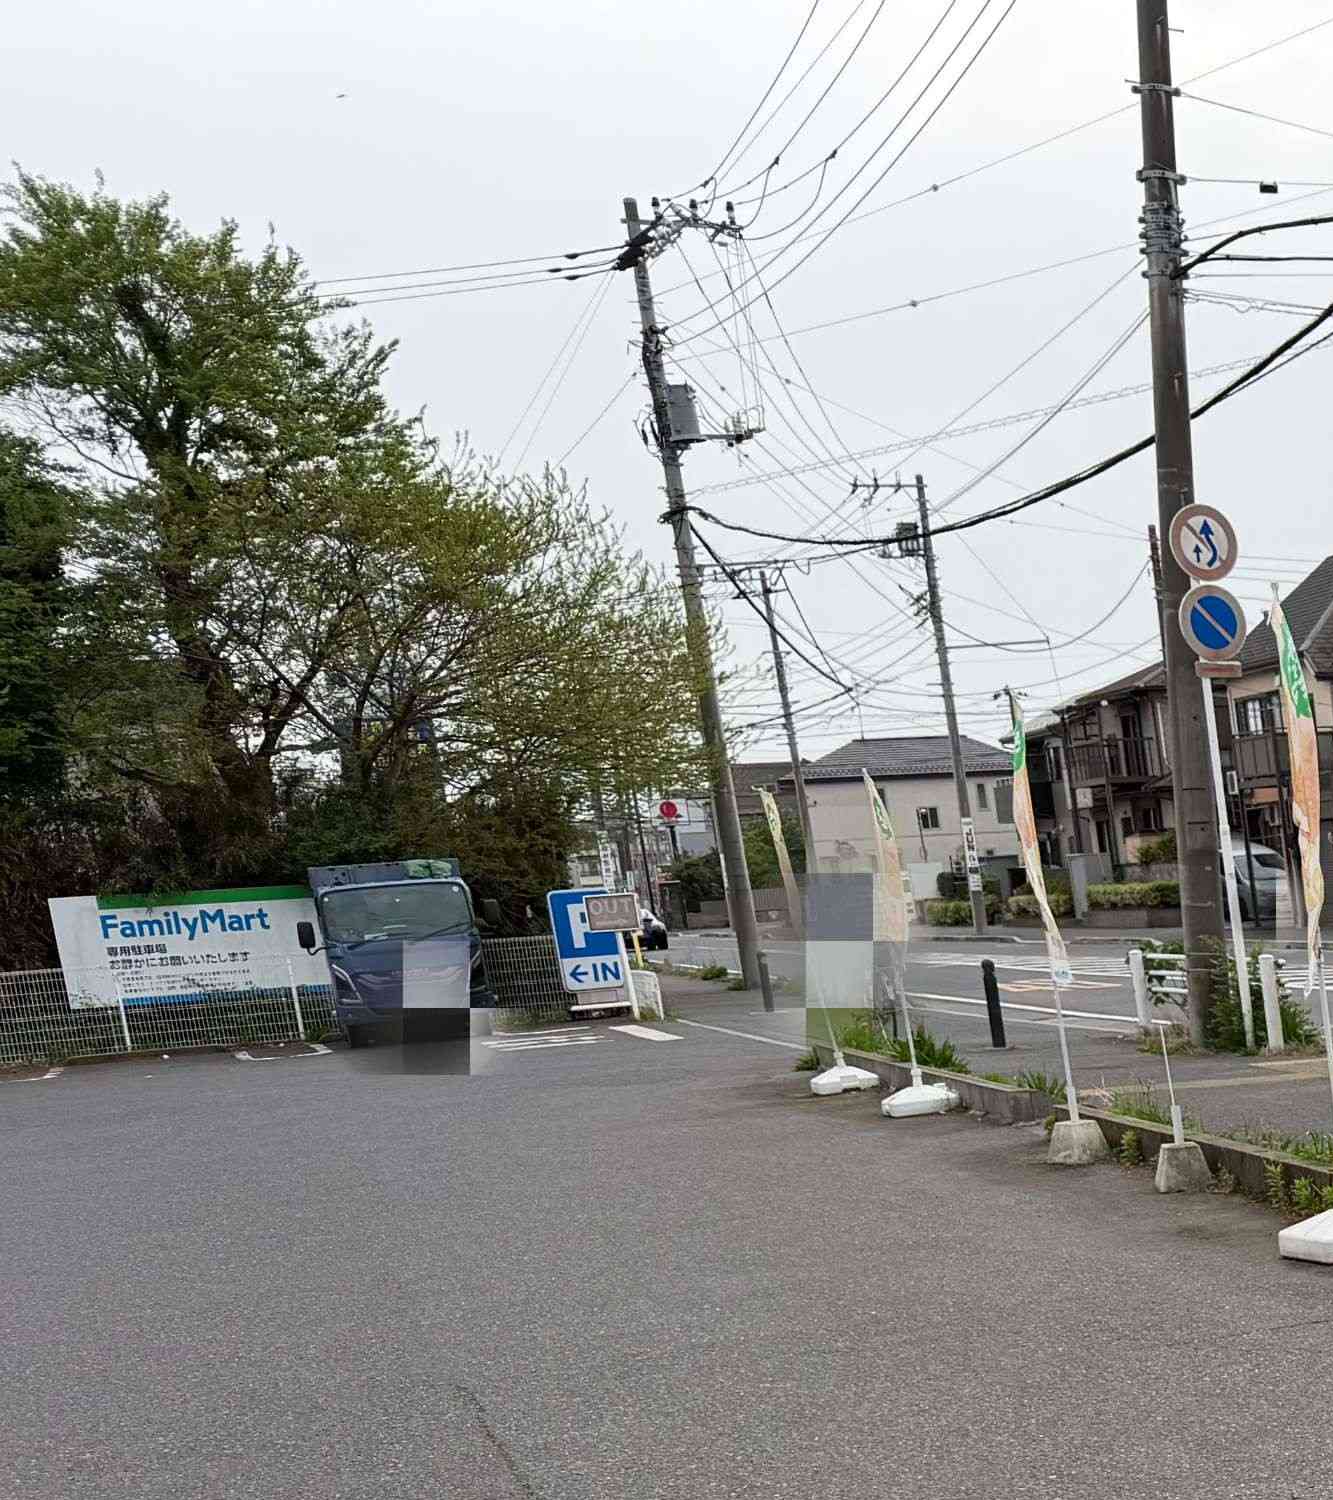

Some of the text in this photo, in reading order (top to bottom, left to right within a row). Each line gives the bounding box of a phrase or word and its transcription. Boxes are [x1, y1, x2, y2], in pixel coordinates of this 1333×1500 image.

[589, 897, 632, 916] OUT
[99, 907, 271, 941] FamilyMart
[591, 961, 621, 982] IN
